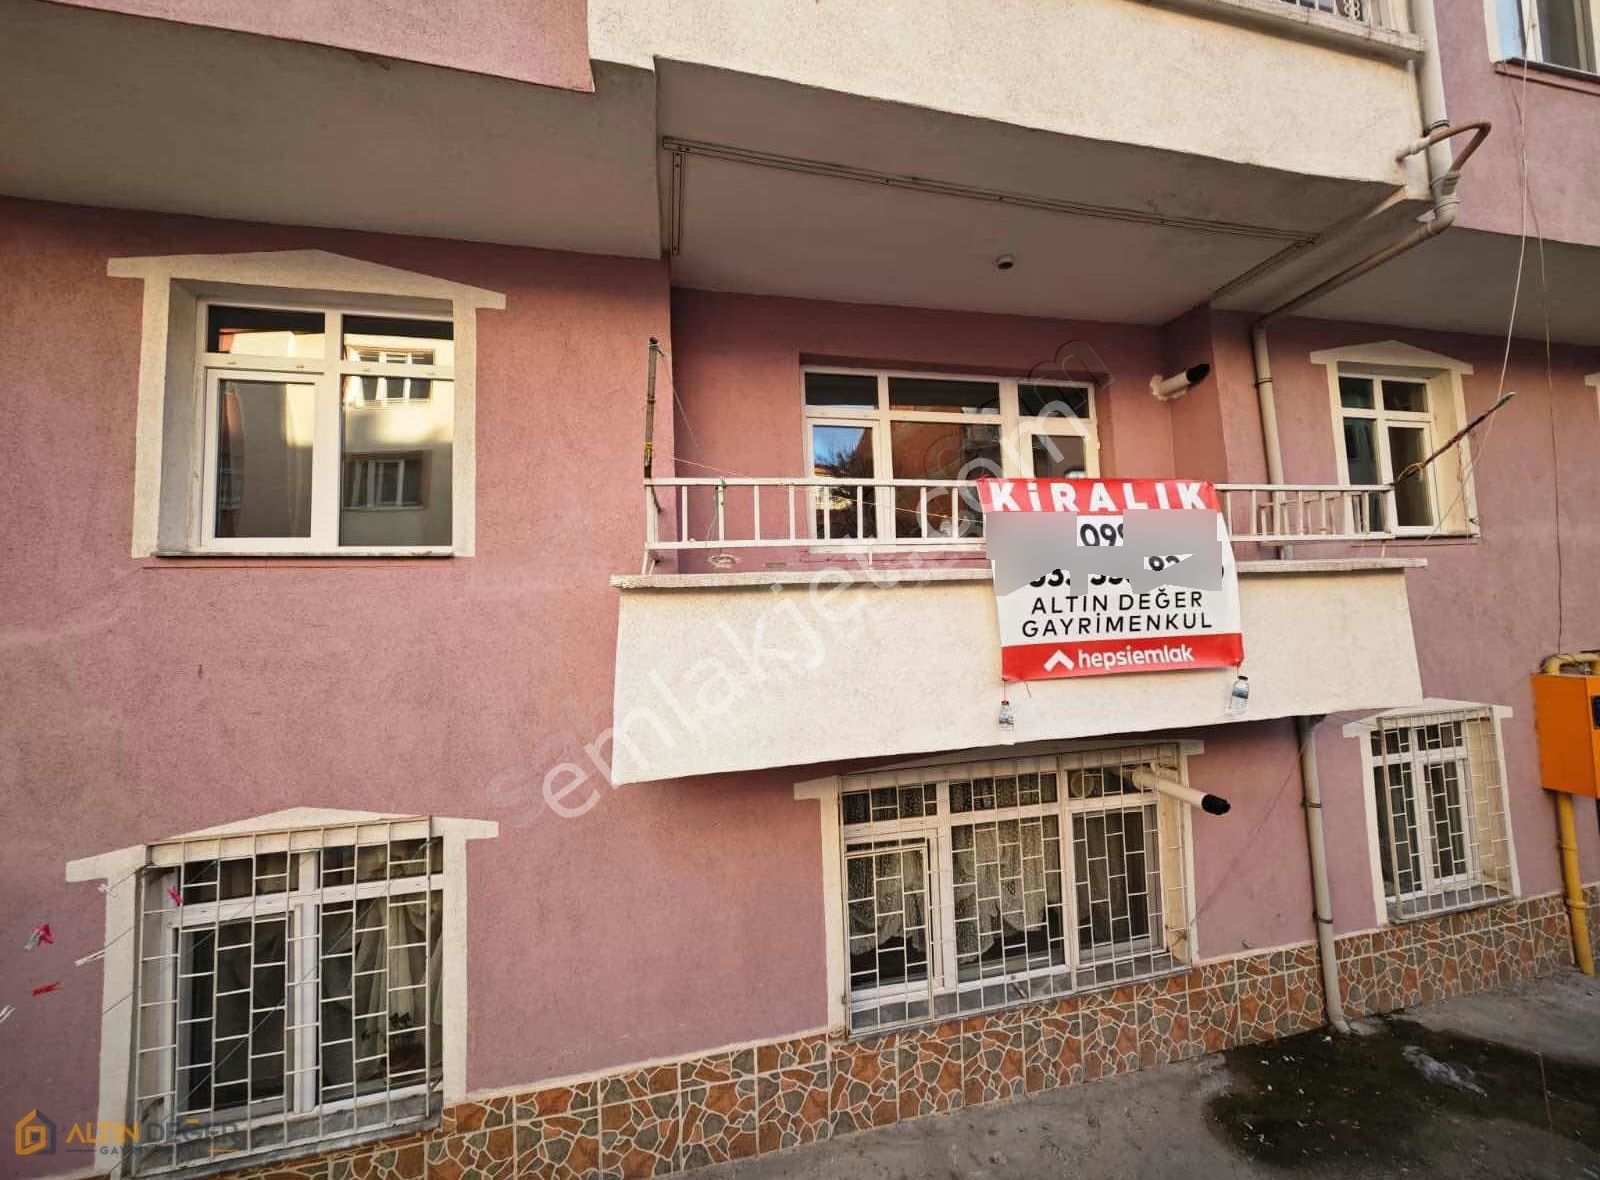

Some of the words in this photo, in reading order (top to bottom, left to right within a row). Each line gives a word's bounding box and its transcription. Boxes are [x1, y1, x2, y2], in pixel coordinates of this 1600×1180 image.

[1031, 596, 1108, 615] ALTIN
[1118, 588, 1203, 611] DEĞER
[1021, 611, 1213, 638] GAYRİMENKUL
[1077, 643, 1194, 671] hepsiemlak
